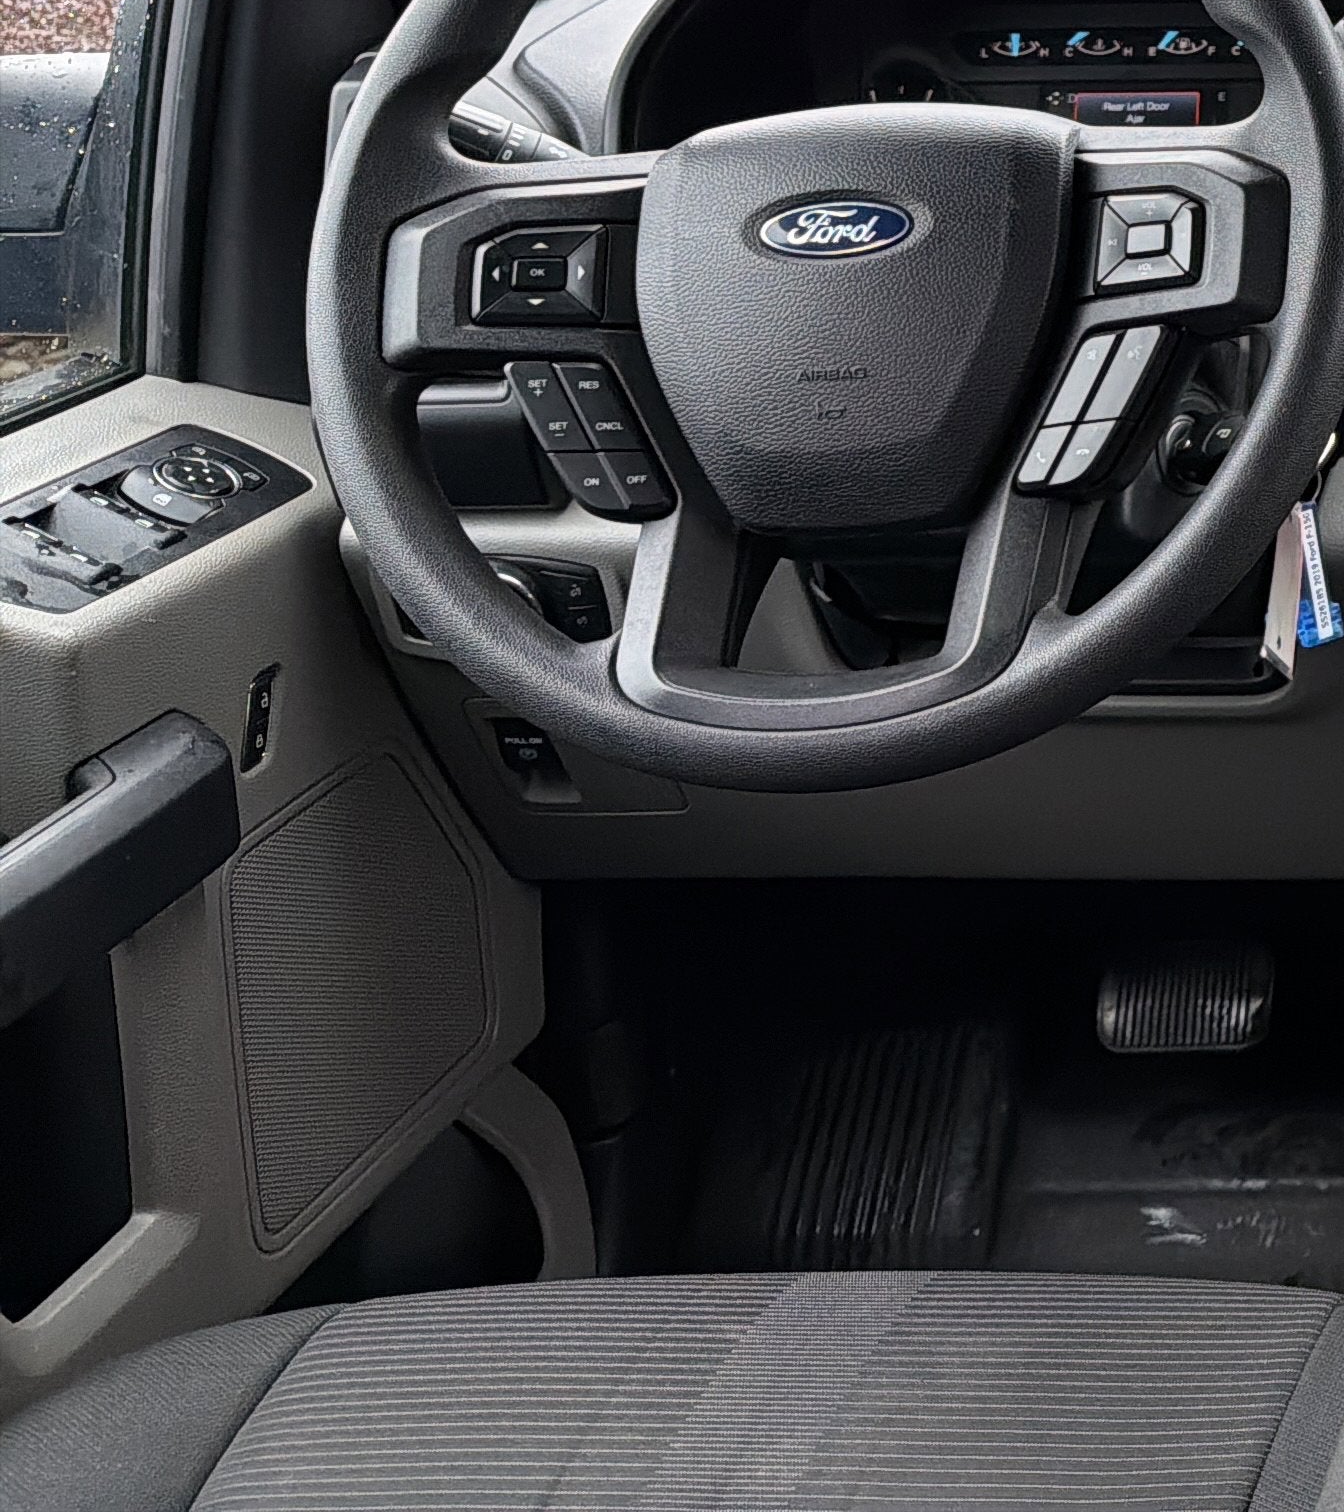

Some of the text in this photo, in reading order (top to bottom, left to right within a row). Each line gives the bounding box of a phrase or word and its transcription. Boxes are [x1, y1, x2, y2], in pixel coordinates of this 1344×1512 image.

[1103, 101, 1171, 112] Rear Left Door
[786, 207, 881, 245] Ford
[530, 268, 545, 277] OK
[798, 365, 868, 382] AIRBAG
[527, 378, 549, 389] SET
[578, 380, 600, 390] RES
[548, 421, 569, 432] SET
[595, 421, 624, 432] CNCL
[583, 477, 600, 487] ON
[626, 474, 648, 485] OFF
[1308, 540, 1319, 562] Ford
[1311, 563, 1323, 586] 2019
